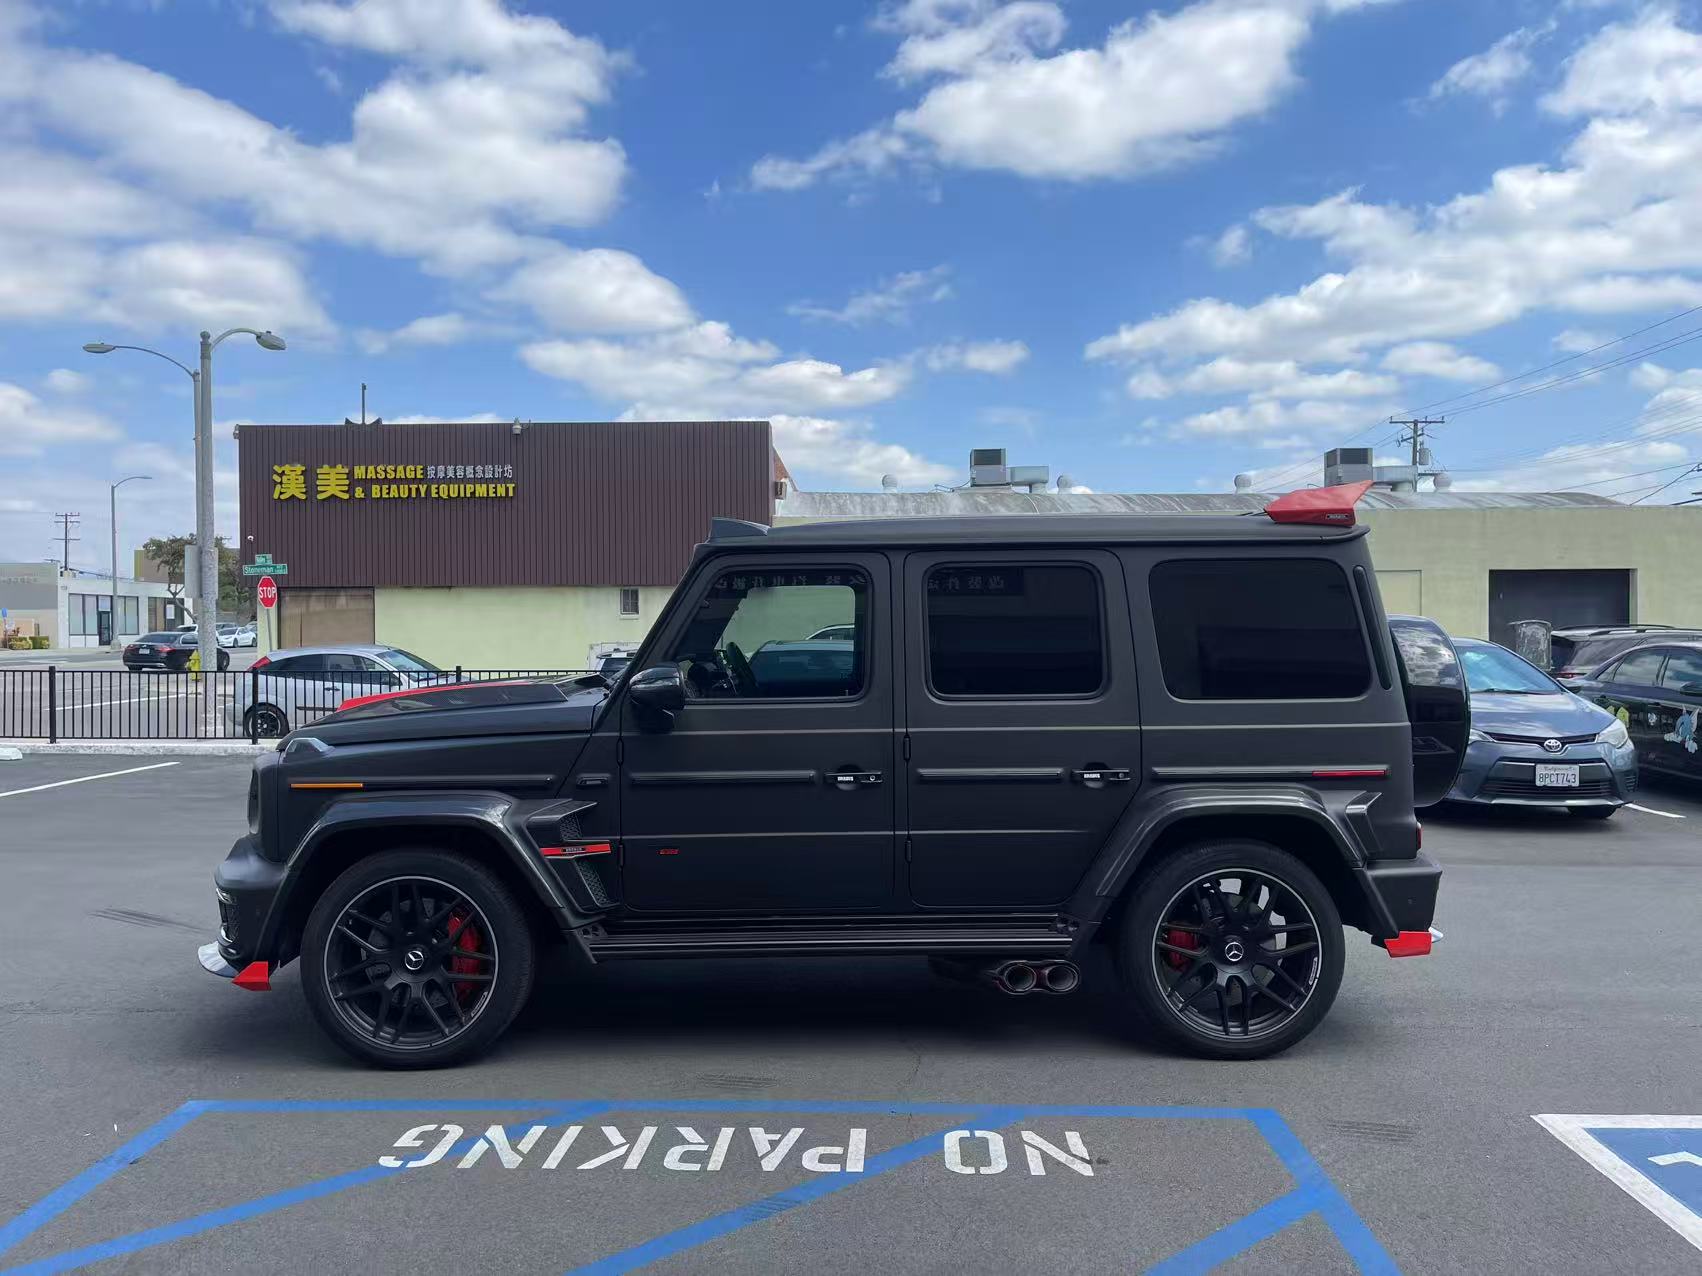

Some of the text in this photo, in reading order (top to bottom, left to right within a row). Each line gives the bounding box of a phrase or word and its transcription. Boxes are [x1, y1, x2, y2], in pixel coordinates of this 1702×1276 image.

[353, 465, 424, 479] MASSAGE
[354, 483, 515, 499] & BEAUTY EQUIPMENT
[259, 587, 277, 599] STOP
[1538, 772, 1577, 784] 8PCT743
[378, 1124, 1095, 1177] NO PARKING
